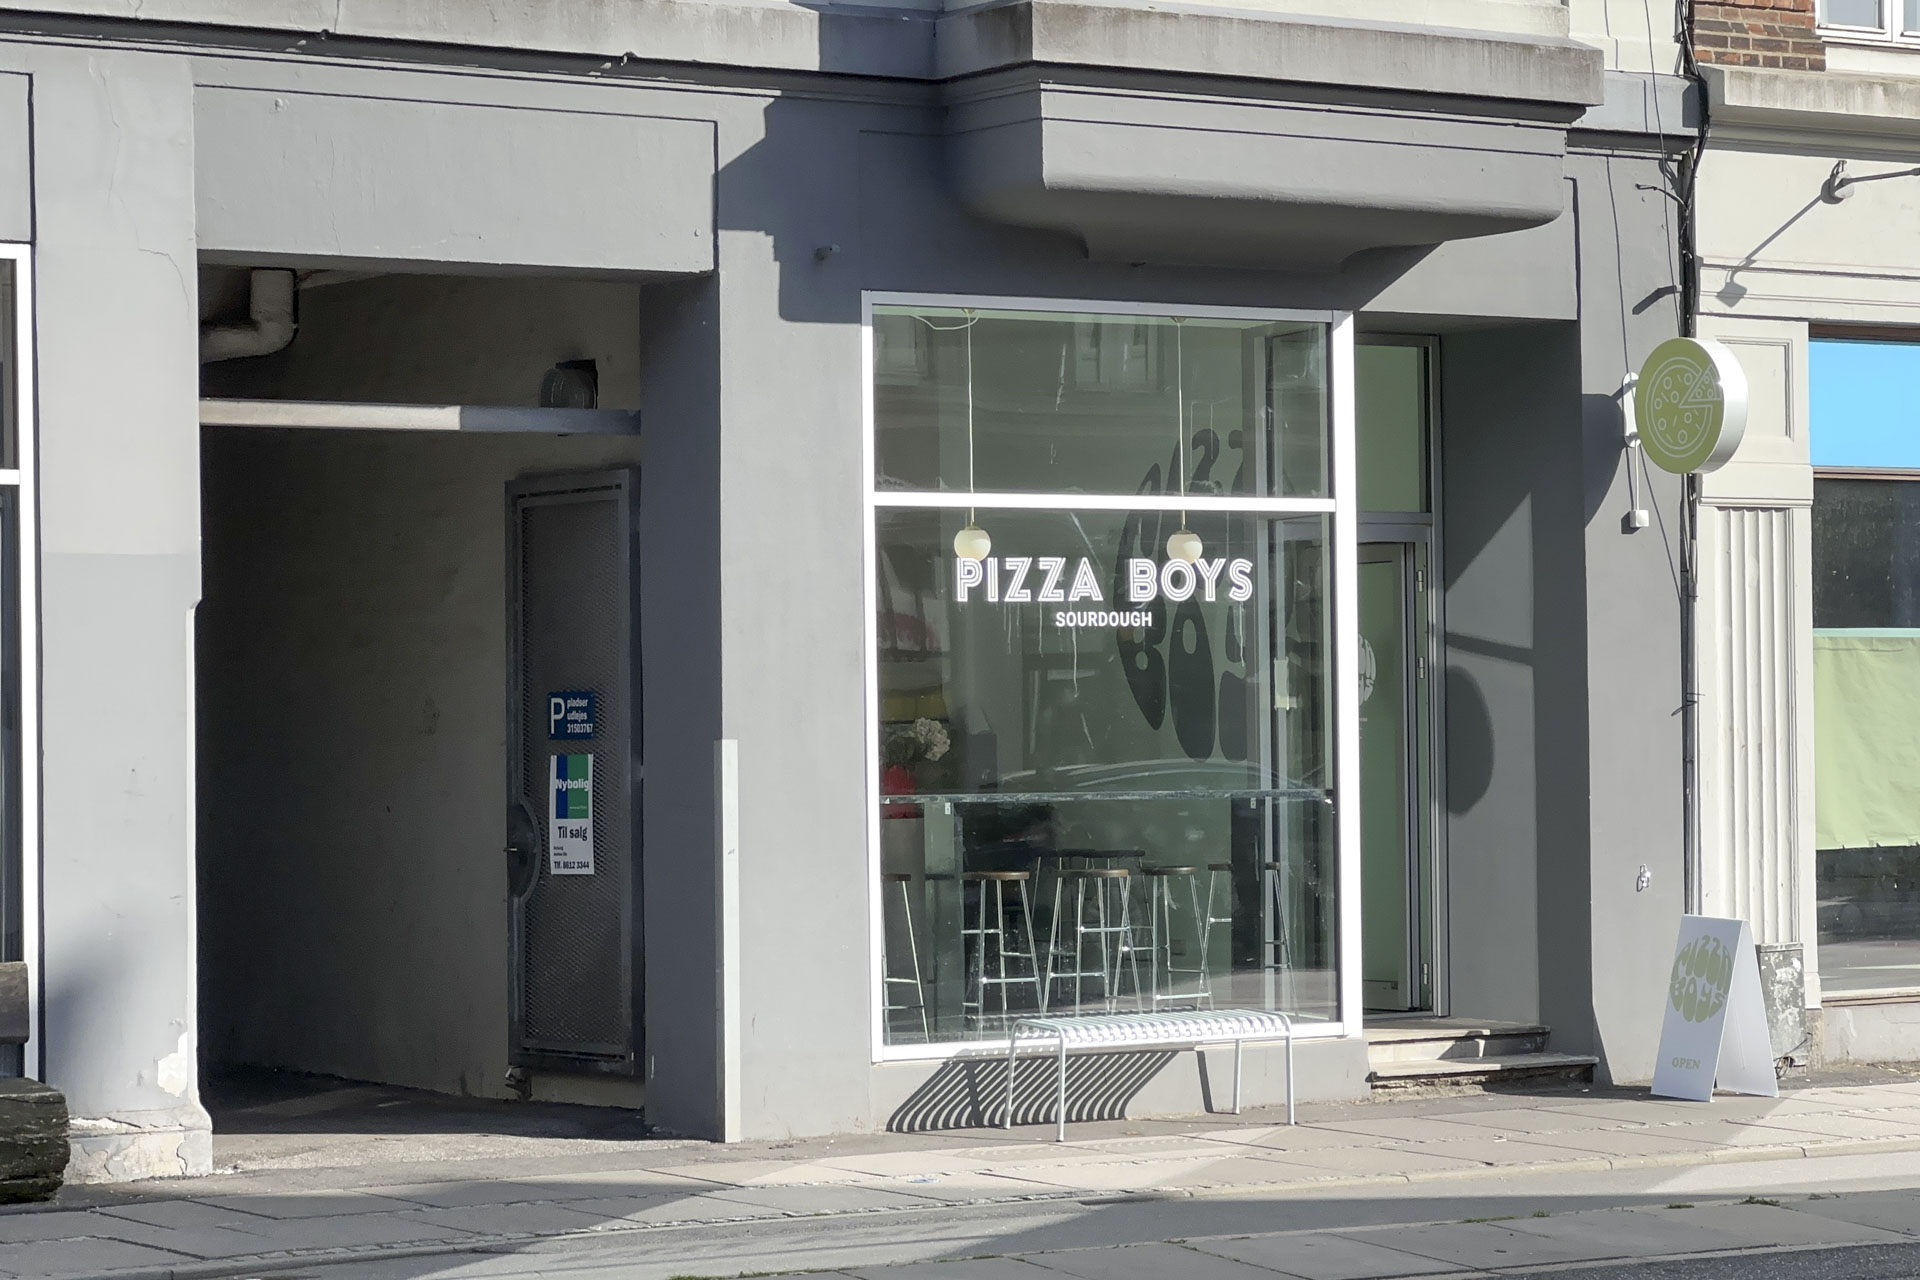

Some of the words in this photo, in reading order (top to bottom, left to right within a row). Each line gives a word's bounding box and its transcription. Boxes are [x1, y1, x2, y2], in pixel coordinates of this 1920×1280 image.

[956, 557, 1103, 602] PIZZA
[1129, 558, 1253, 602] BOYS
[1055, 611, 1152, 627] SOURDOUGH
[567, 697, 588, 709] pladser
[551, 698, 565, 734] P
[567, 710, 587, 722] udlejes
[556, 778, 589, 791] Nybolig
[558, 826, 567, 838] Til
[570, 826, 587, 841] salg
[1671, 935, 1732, 995] PIZZA
[1670, 976, 1727, 1023] BOYS
[1671, 1057, 1700, 1069] OPEN
